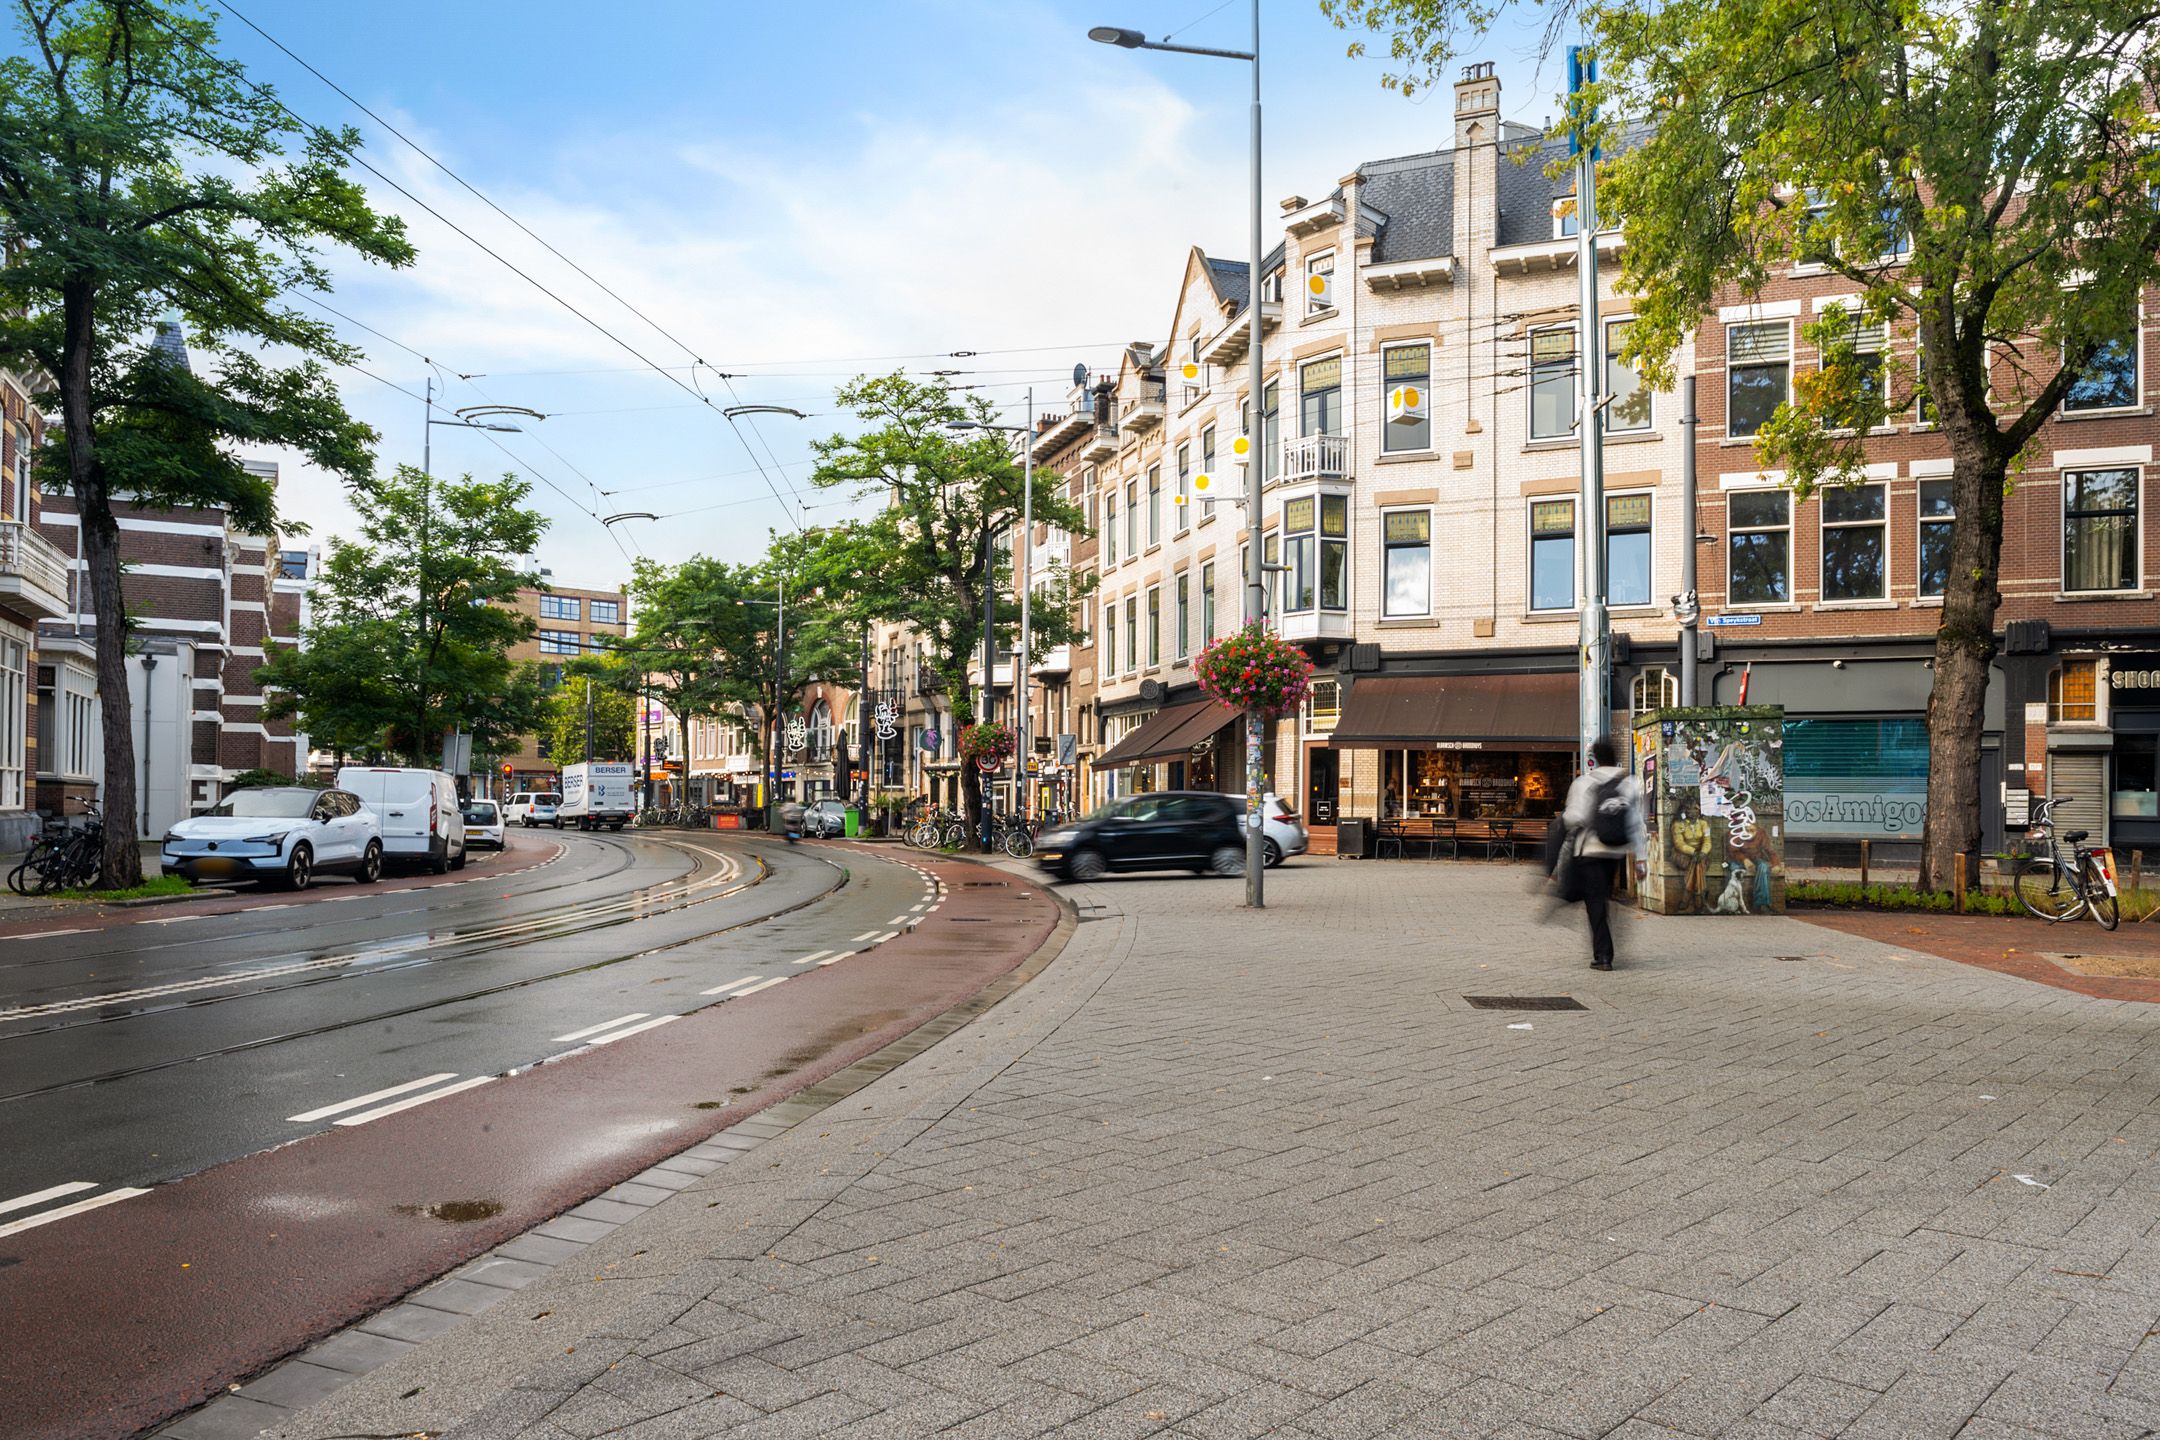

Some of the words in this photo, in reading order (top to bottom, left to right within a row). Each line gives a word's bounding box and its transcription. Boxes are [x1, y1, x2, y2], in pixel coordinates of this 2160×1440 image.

[982, 756, 996, 765] 30
[595, 766, 626, 774] BERSER
[564, 774, 583, 789] BERSER
